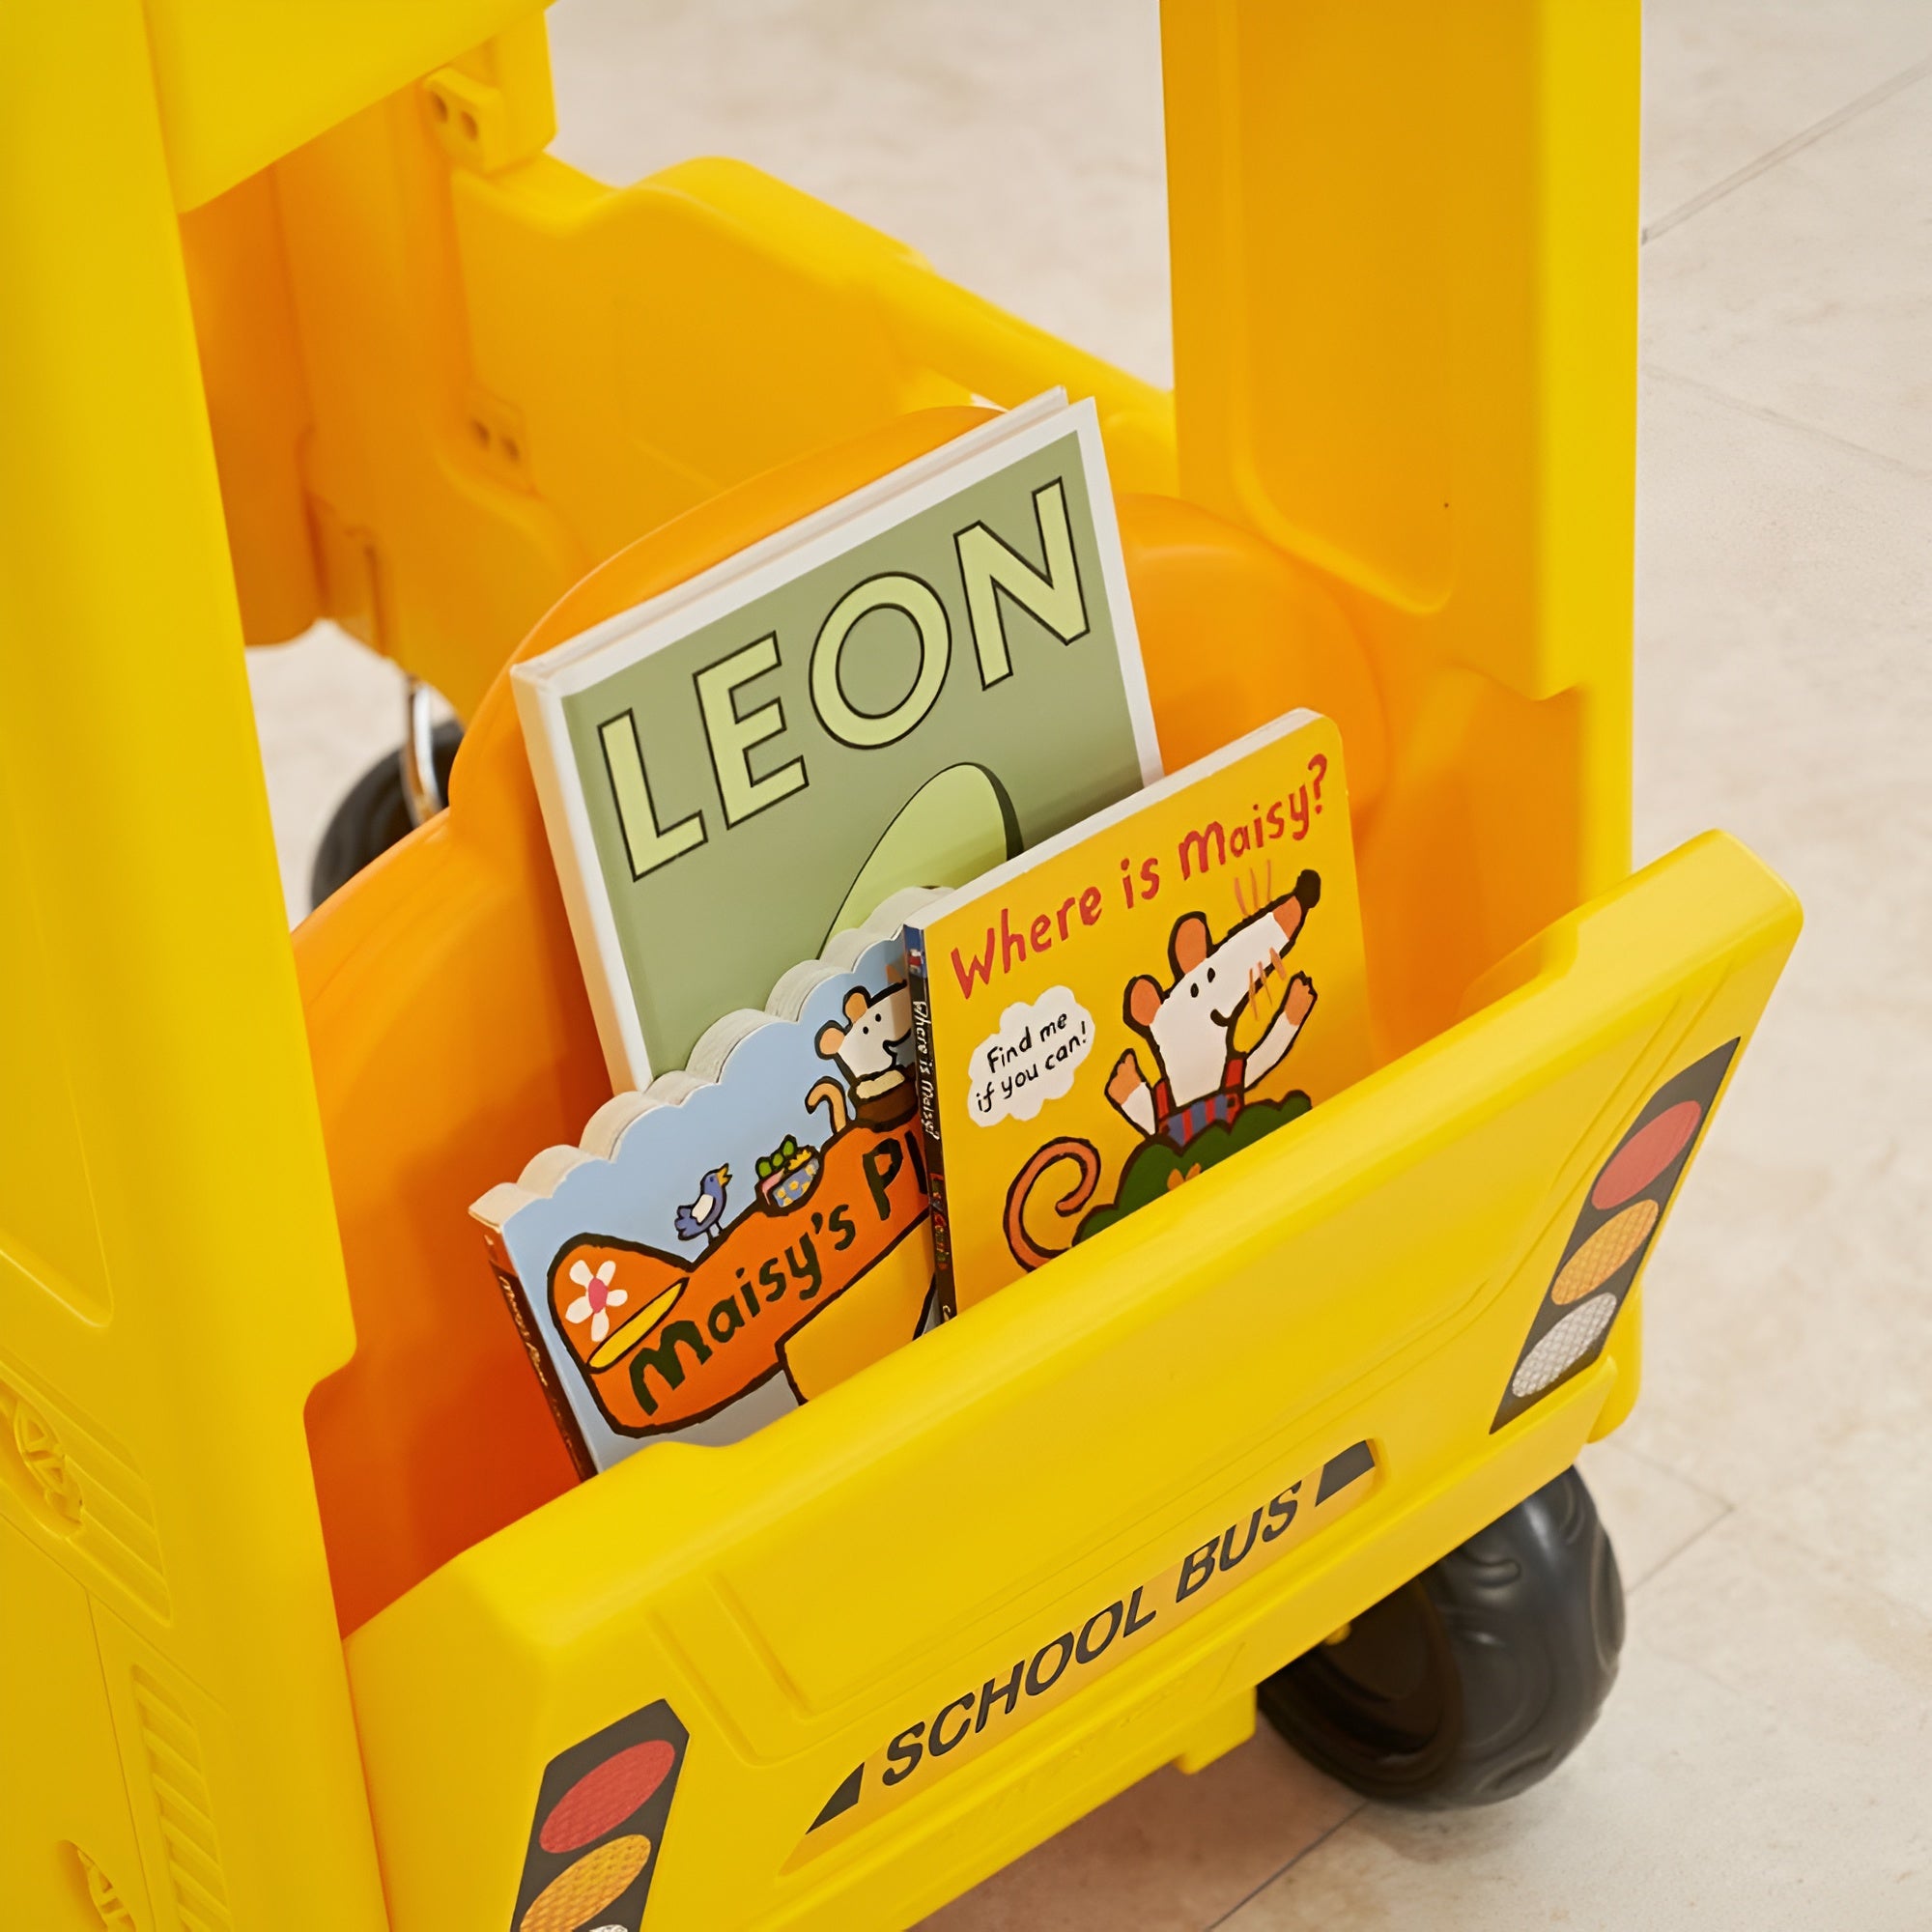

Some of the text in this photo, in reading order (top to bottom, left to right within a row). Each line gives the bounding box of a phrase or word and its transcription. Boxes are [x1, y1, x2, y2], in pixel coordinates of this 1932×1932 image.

[596, 475, 1091, 883] LEON
[950, 753, 1327, 1000] Where is Maisy?
[976, 1020, 1087, 1113] if you can!
[986, 1012, 1067, 1074] Find me
[628, 1203, 857, 1416] Maisy's
[862, 1130, 929, 1222] Pl
[881, 1480, 1302, 1786] SCHOOL BUS
